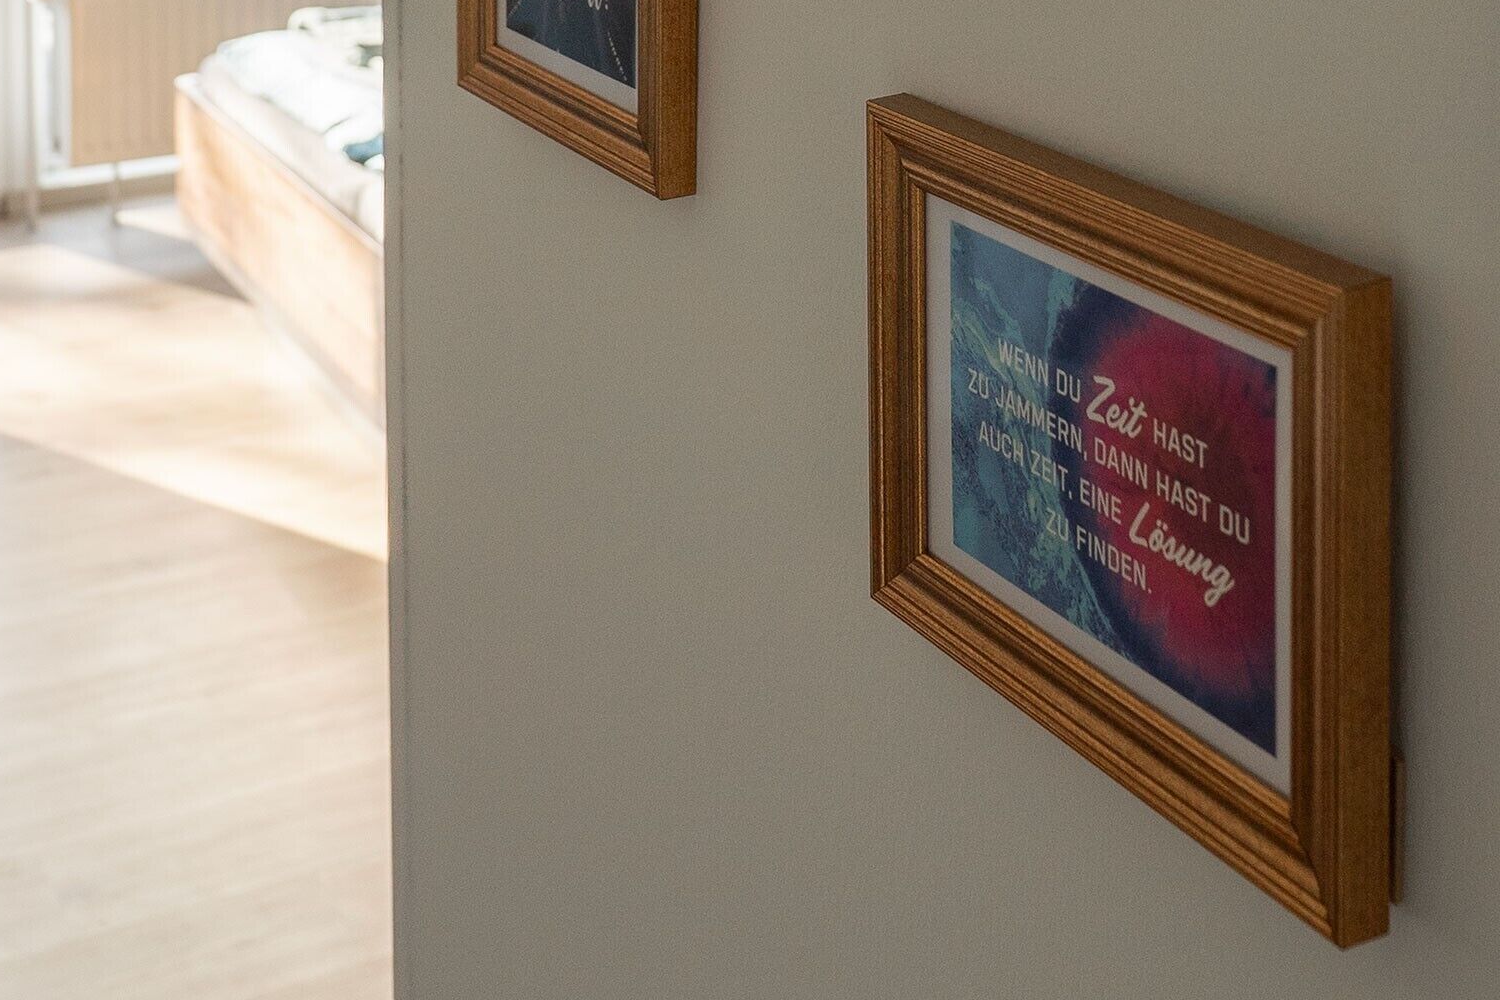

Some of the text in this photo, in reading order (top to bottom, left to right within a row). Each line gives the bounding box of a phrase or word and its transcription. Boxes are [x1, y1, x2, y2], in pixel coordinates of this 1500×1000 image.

[967, 367, 1250, 545] ZU JAMMERN, DANN HAST DU
[998, 338, 1208, 469] WENN DU Zeit HAST
[979, 421, 1024, 468] AUCH
[1079, 478, 1123, 525] EINE
[1128, 502, 1236, 608] Lösung
[1045, 507, 1152, 594] ZU FINDEN.
